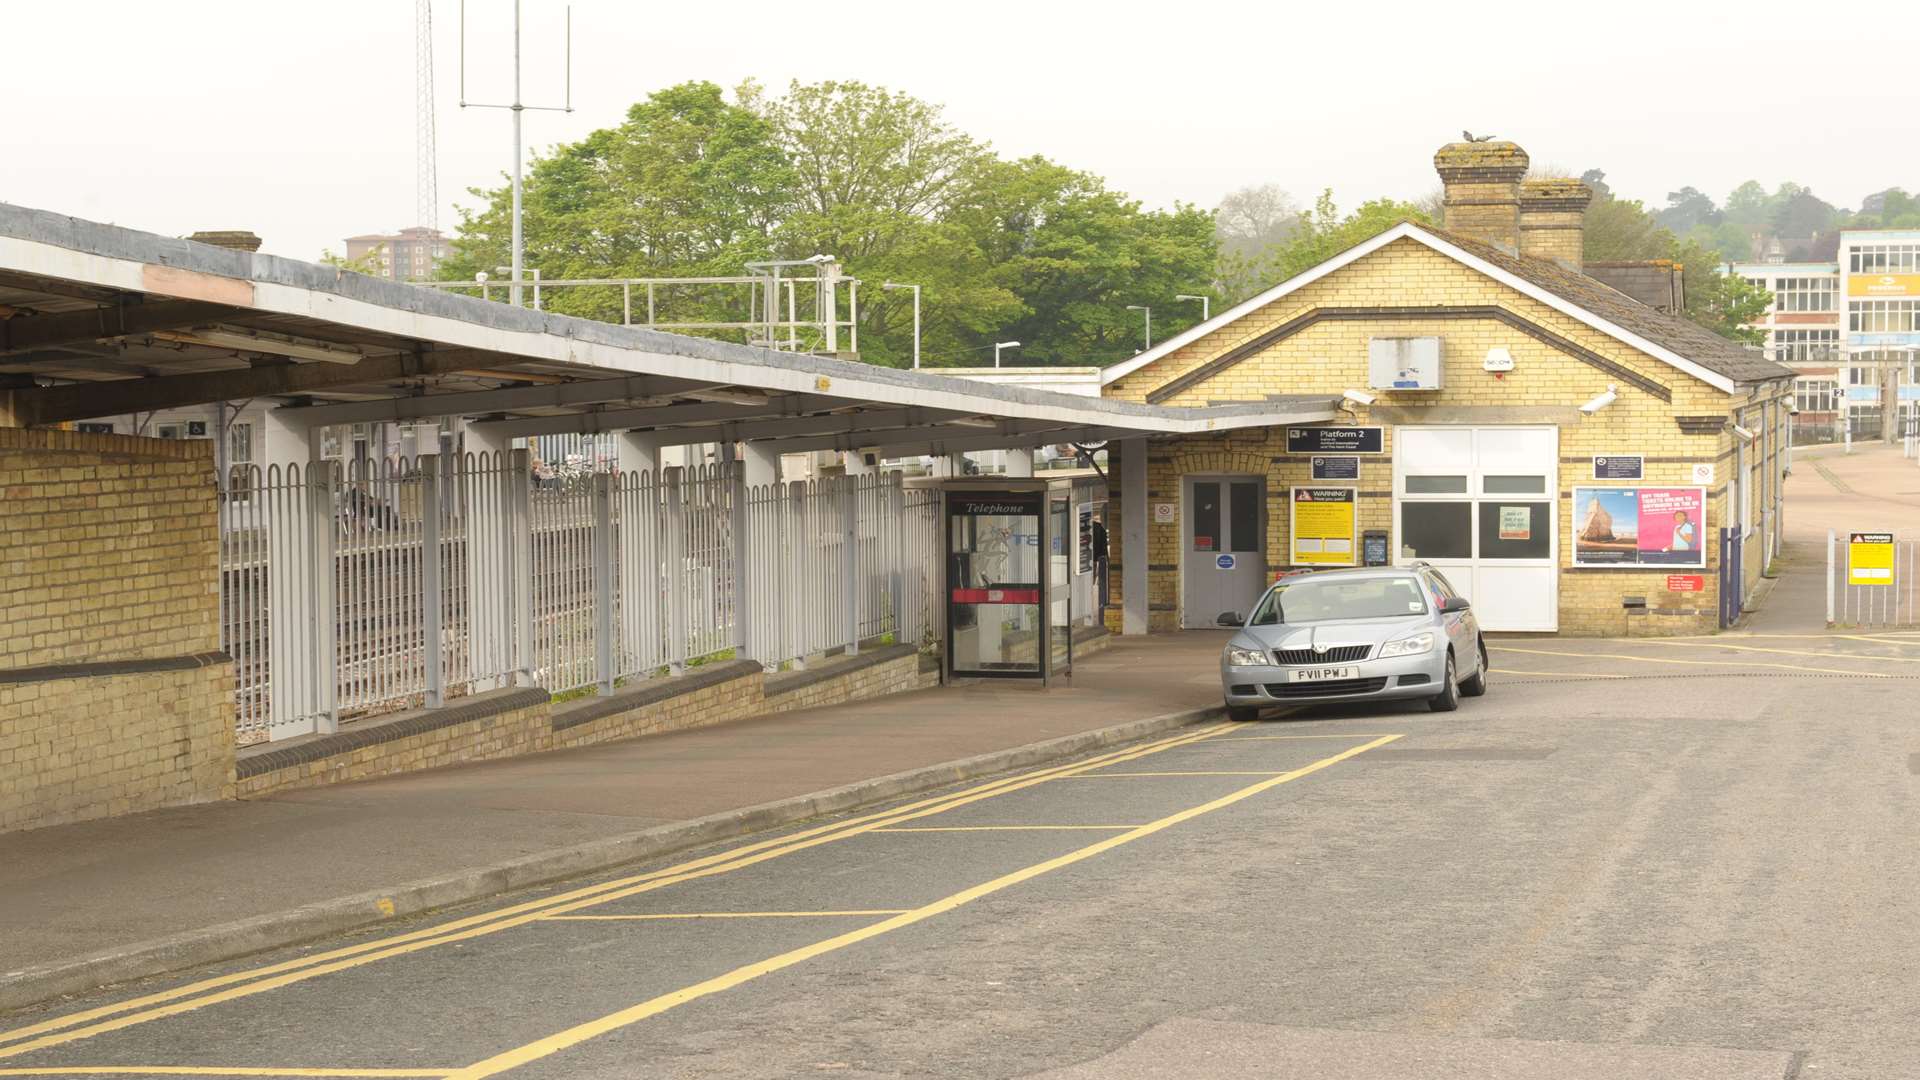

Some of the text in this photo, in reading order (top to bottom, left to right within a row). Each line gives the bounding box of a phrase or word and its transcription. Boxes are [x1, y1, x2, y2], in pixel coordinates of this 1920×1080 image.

[1320, 430, 1357, 438] Platform
[966, 503, 1024, 514] Telephone
[1298, 667, 1348, 679] FV11 PWJ
